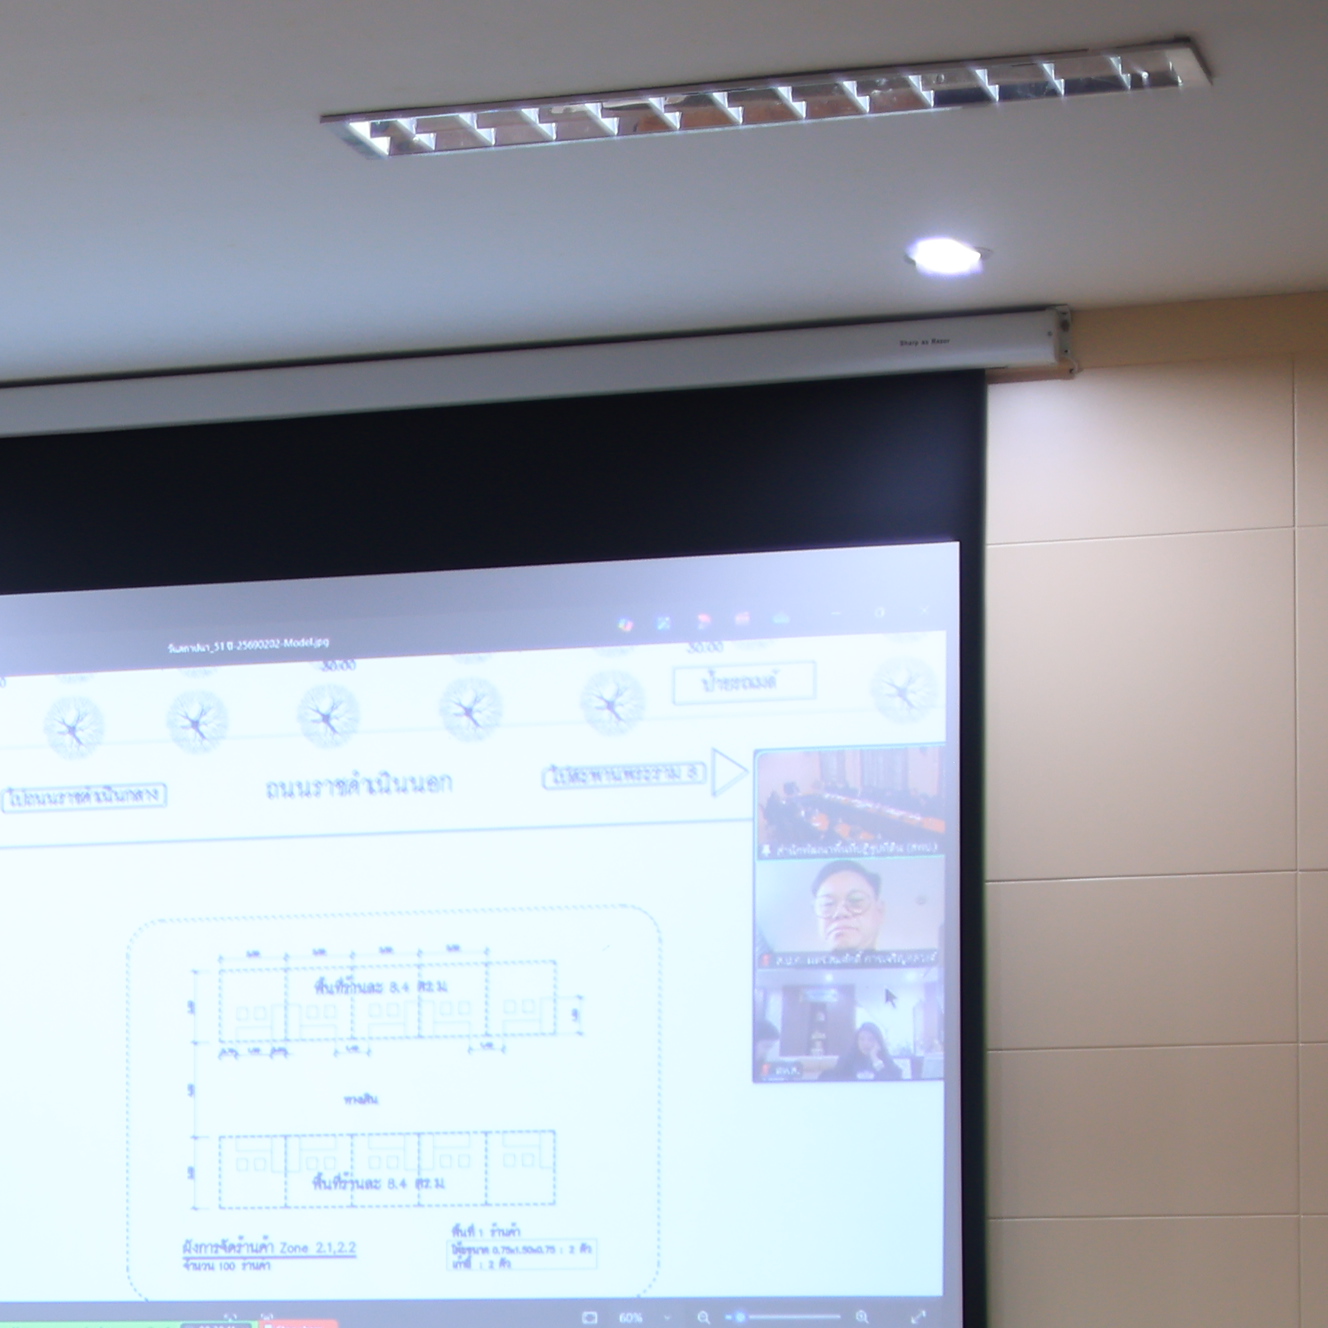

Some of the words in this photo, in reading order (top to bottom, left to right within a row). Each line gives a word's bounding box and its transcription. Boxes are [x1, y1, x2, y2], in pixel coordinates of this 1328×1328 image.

[265, 769, 453, 800] ถนนราชดำเนินนอก
[490, 1222, 521, 1238] ร้านค้า
[182, 1234, 275, 1255] ผังการจัดร้านค้า
[279, 1241, 309, 1254] Zone
[315, 1241, 357, 1256] 2.1,2.2
[219, 1261, 236, 1271] 100
[619, 1311, 643, 1324] 60%
